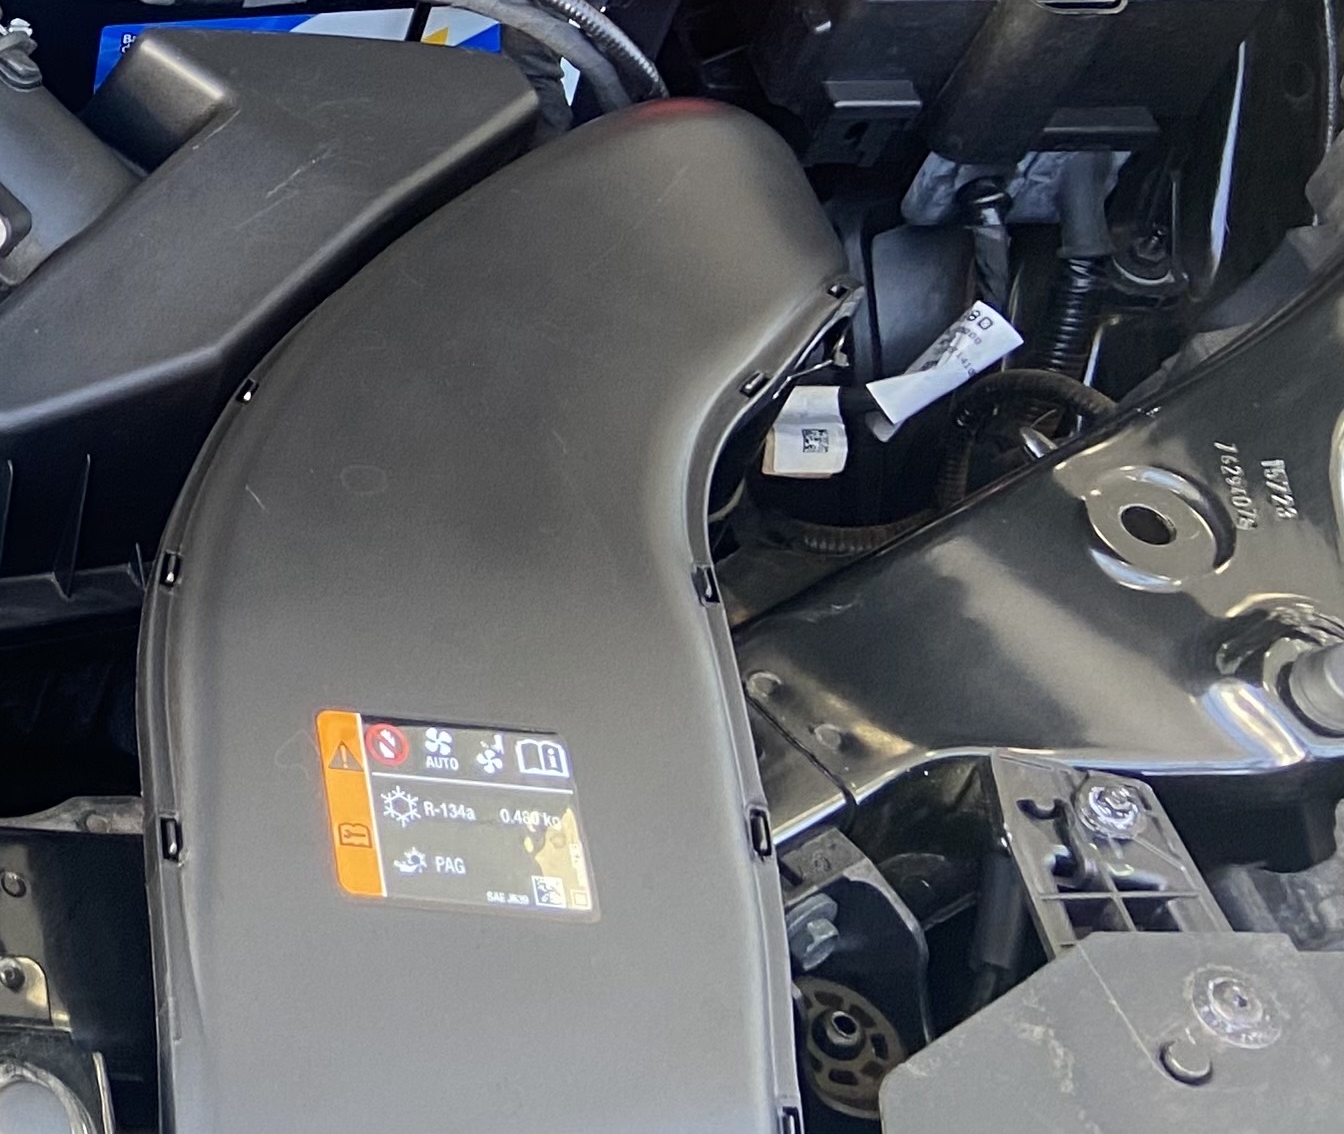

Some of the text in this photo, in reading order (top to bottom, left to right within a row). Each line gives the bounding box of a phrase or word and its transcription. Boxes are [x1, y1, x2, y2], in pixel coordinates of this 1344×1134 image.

[426, 756, 459, 771] AUTO
[424, 801, 477, 821] R-134a
[435, 856, 466, 875] PAG
